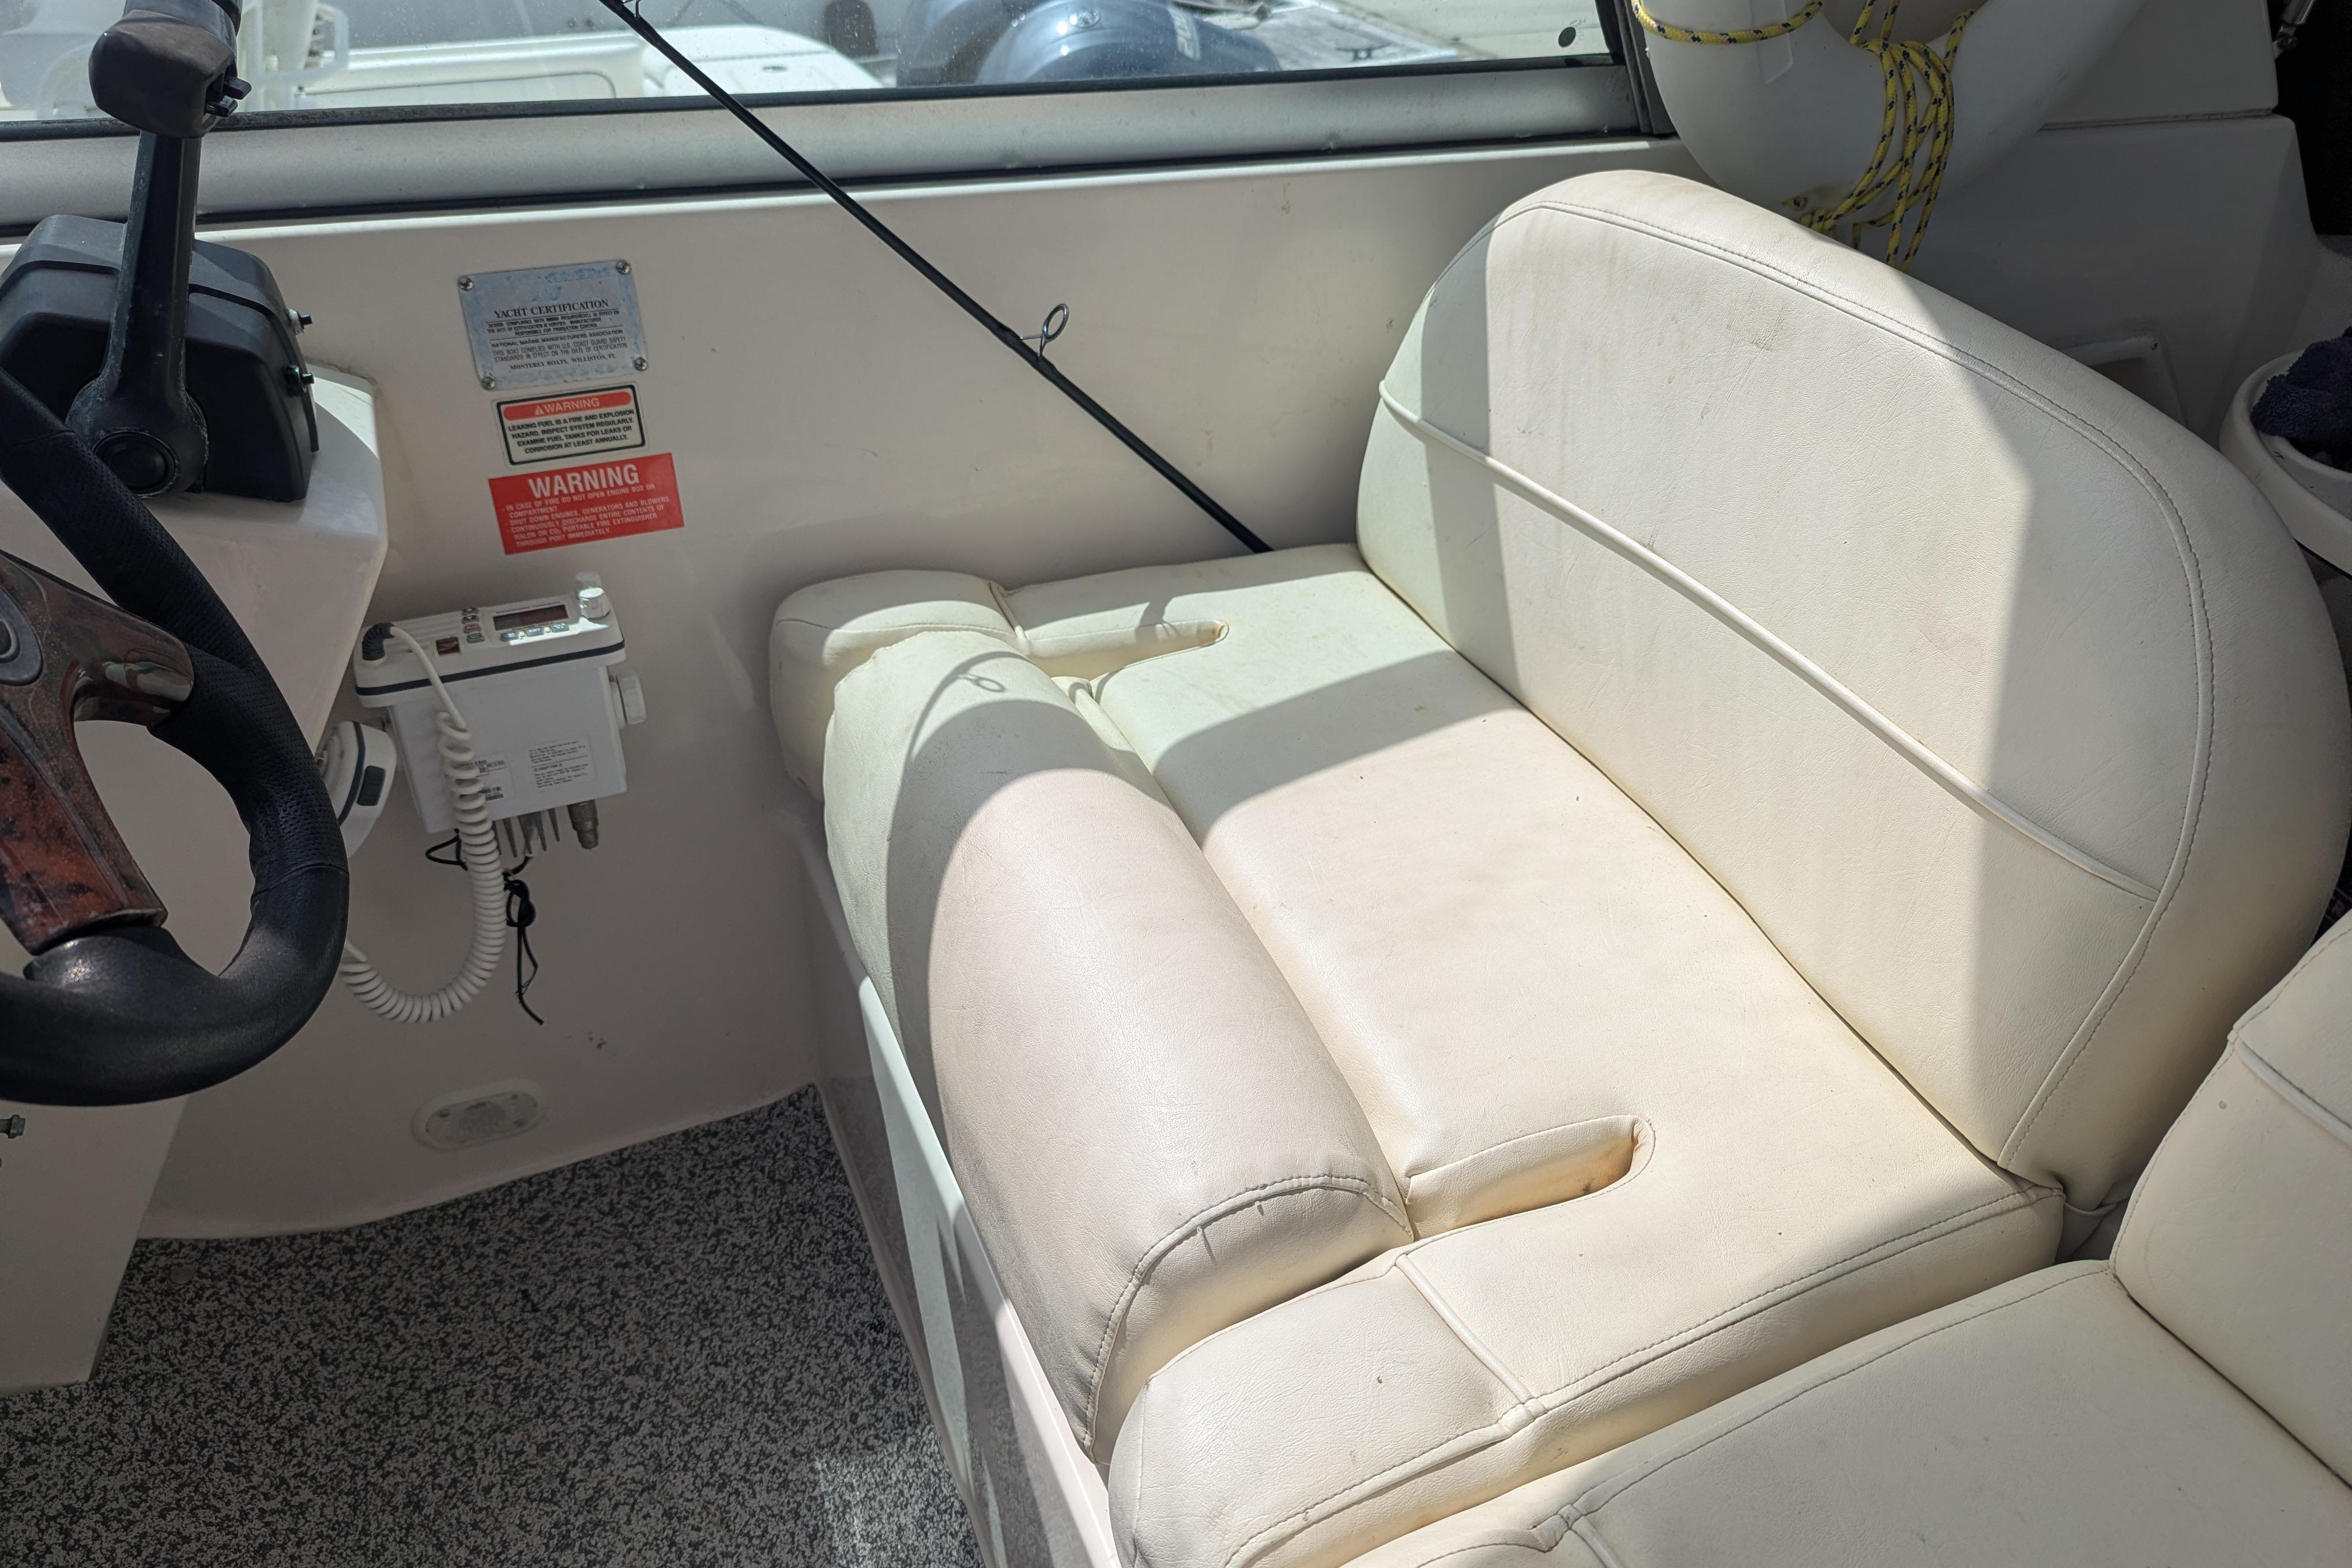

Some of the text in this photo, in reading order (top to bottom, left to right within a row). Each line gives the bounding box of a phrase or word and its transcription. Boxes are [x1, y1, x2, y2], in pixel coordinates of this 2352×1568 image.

[495, 299, 609, 318] YACHT CERTIFICATION
[541, 334, 587, 342] MANUFACTURERS
[589, 329, 623, 337] ASSOCIATION
[495, 355, 524, 363] STANDARDS
[593, 343, 628, 351] CERTIFICATION
[521, 345, 546, 353] COMPLIES
[510, 362, 545, 370] MONTEREY
[544, 398, 601, 413] WARNING
[508, 423, 537, 431] LEAKING
[599, 410, 635, 419] EXPLOSION
[512, 418, 634, 439] HAZARD. INSPECT SYSTEM REGULARLY.
[518, 438, 546, 447] EXAMINE
[525, 444, 563, 454] CORROSION
[594, 435, 628, 444] ANNUALLY.
[528, 464, 640, 499] WARNING
[517, 502, 533, 510] CASE
[545, 498, 560, 506] FIRE
[589, 492, 605, 500] OPEN
[608, 488, 630, 497] ENGINE
[510, 506, 560, 519] COMPARTMENT.
[510, 518, 527, 526] SHUT
[529, 515, 549, 523] DOWN
[583, 504, 624, 515] GENERATORS
[512, 520, 560, 533] CONTINUOUSLY
[562, 515, 597, 526] DISCHARGE
[600, 511, 622, 520] ENTIRE
[624, 506, 655, 517] CONTENTS
[514, 532, 536, 540] HALON
[563, 523, 595, 533] PORTABLE
[613, 514, 658, 526] EXTINGUISHER
[517, 527, 612, 548] THROUGH PORT IMMEDIATELY.
